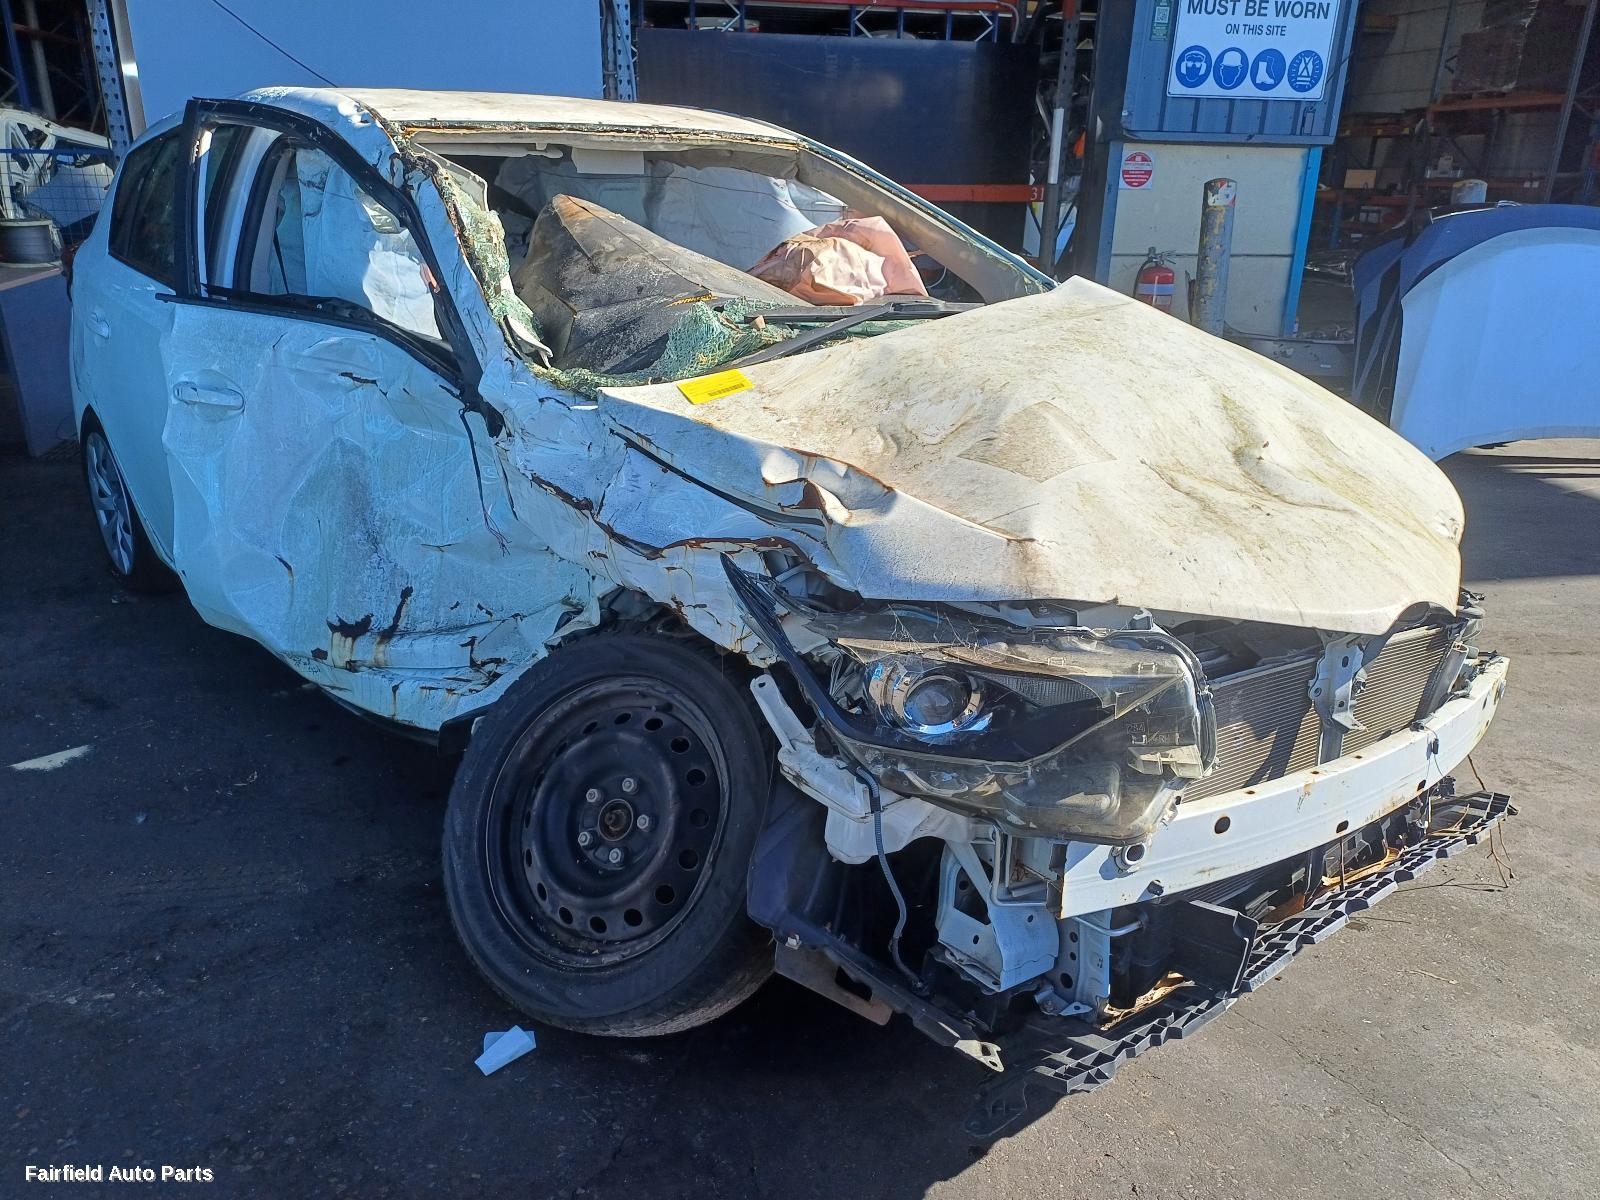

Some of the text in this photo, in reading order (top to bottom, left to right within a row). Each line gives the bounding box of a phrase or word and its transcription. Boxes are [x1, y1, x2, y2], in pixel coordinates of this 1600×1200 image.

[1187, 0, 1330, 19] MUST BE WORN
[1225, 23, 1287, 36] ON THIS SITE
